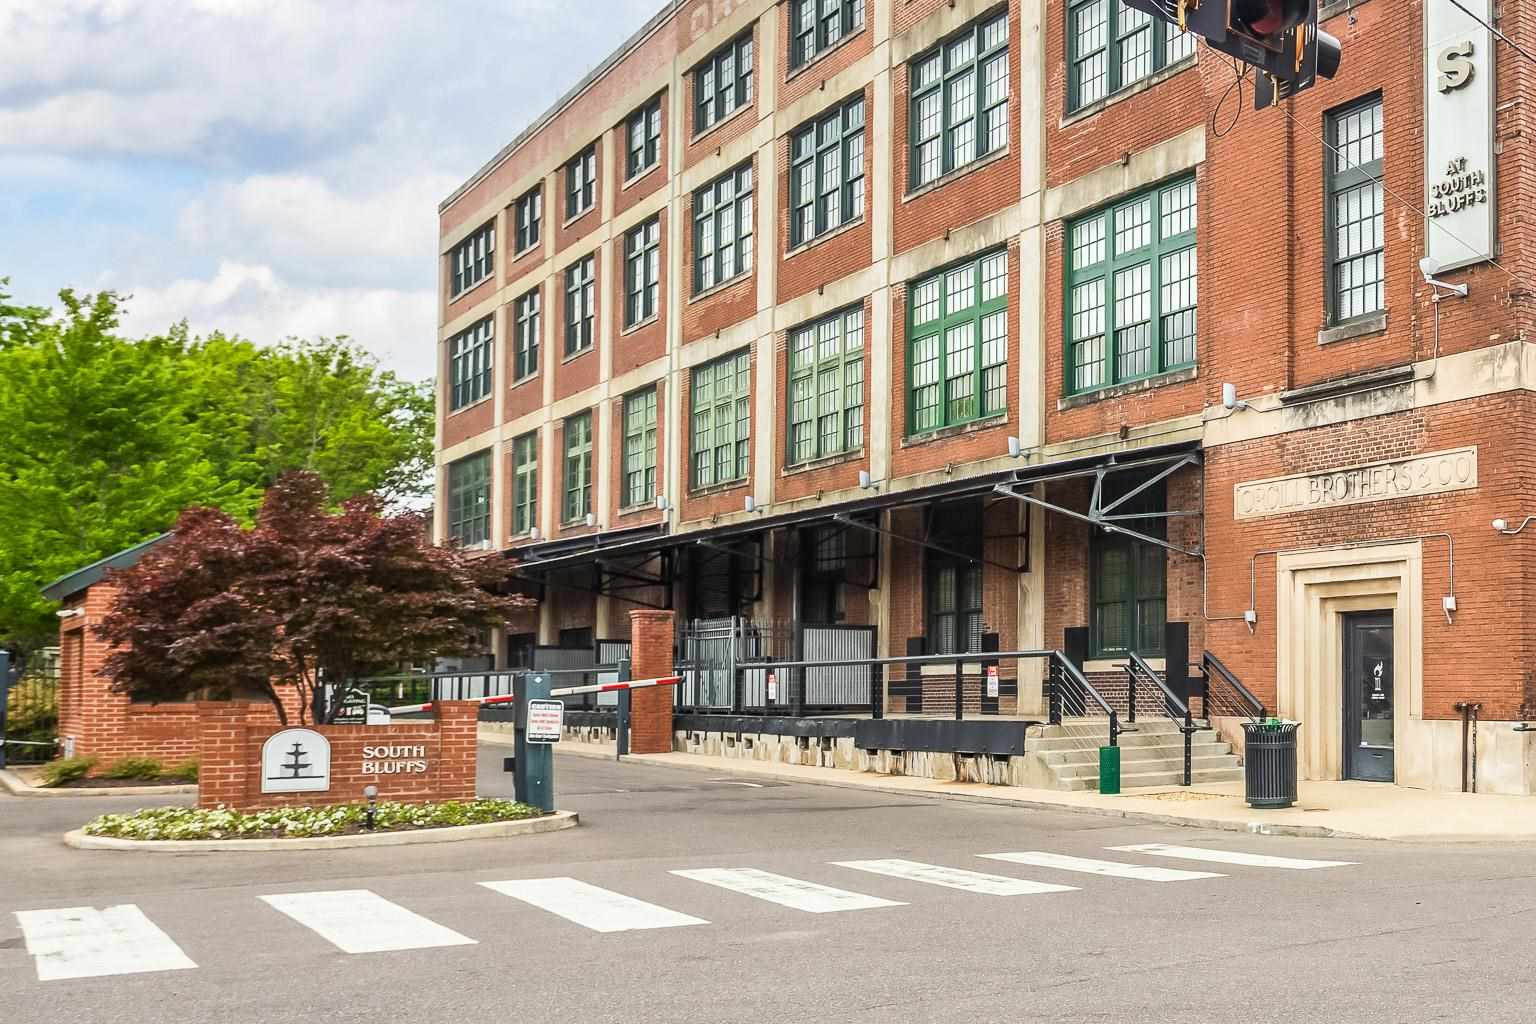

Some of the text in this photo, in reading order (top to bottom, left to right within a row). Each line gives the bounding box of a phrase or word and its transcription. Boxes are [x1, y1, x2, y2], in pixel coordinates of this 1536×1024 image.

[1446, 156, 1467, 176] AT
[1431, 169, 1485, 198] SOUTH
[1428, 189, 1487, 218] BLUFFS
[1308, 465, 1412, 504] BROTHERS
[362, 745, 425, 758] SOUTH
[361, 760, 427, 774] BLUFFS
